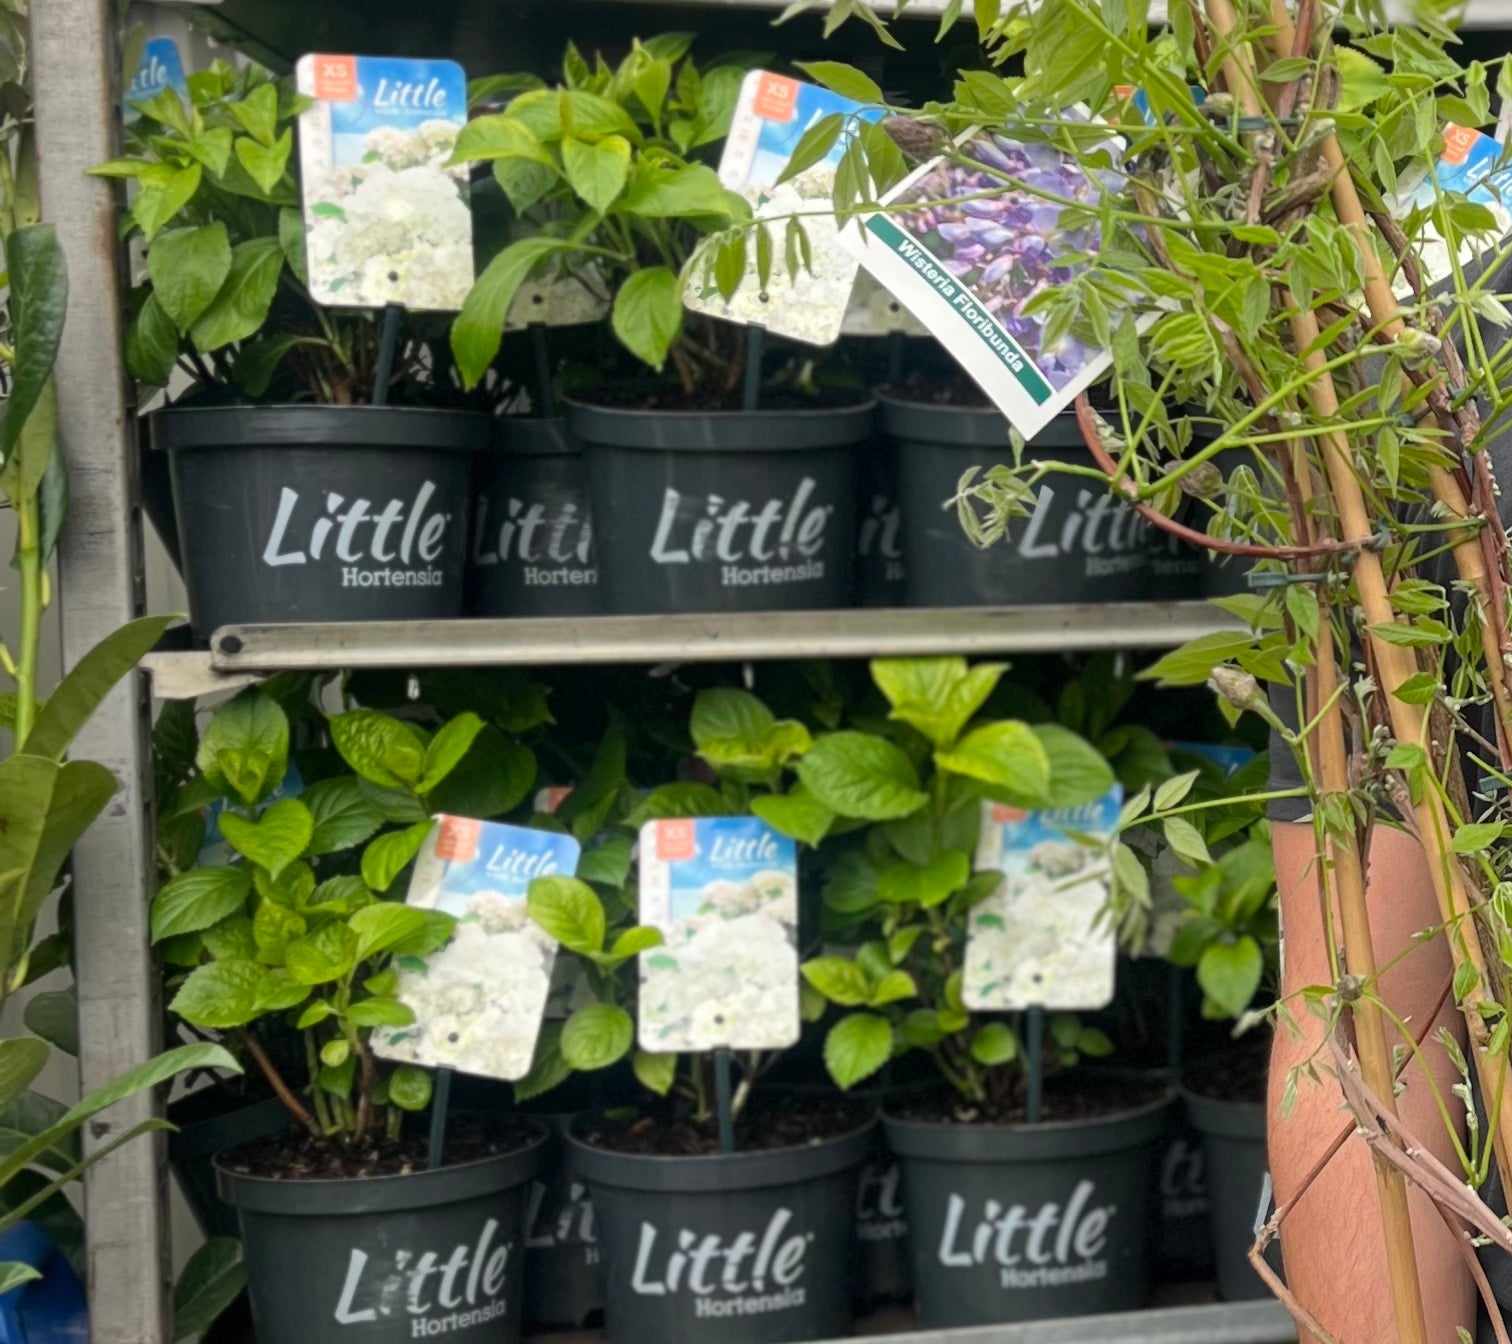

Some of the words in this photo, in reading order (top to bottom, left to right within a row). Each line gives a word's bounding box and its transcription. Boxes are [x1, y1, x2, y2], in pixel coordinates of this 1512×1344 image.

[322, 63, 348, 78] XS
[373, 77, 448, 108] Little
[766, 81, 790, 99] XS
[1451, 129, 1471, 145] XS
[898, 238, 957, 297] Wisteria
[952, 292, 1025, 373] Floribunda
[262, 479, 446, 568] Little
[649, 476, 826, 564] Little
[341, 566, 443, 588] Hortensia
[523, 567, 599, 585] Horten
[720, 559, 825, 587] Hortensia
[486, 844, 559, 877] Little
[709, 832, 779, 861] Little
[938, 1178, 1109, 1267] Little
[632, 1208, 808, 1296] Little
[334, 1218, 510, 1325] Little
[1000, 1259, 1109, 1289] Hortensia
[694, 1286, 807, 1318] Hortensia
[410, 1298, 508, 1339] Hortensia
